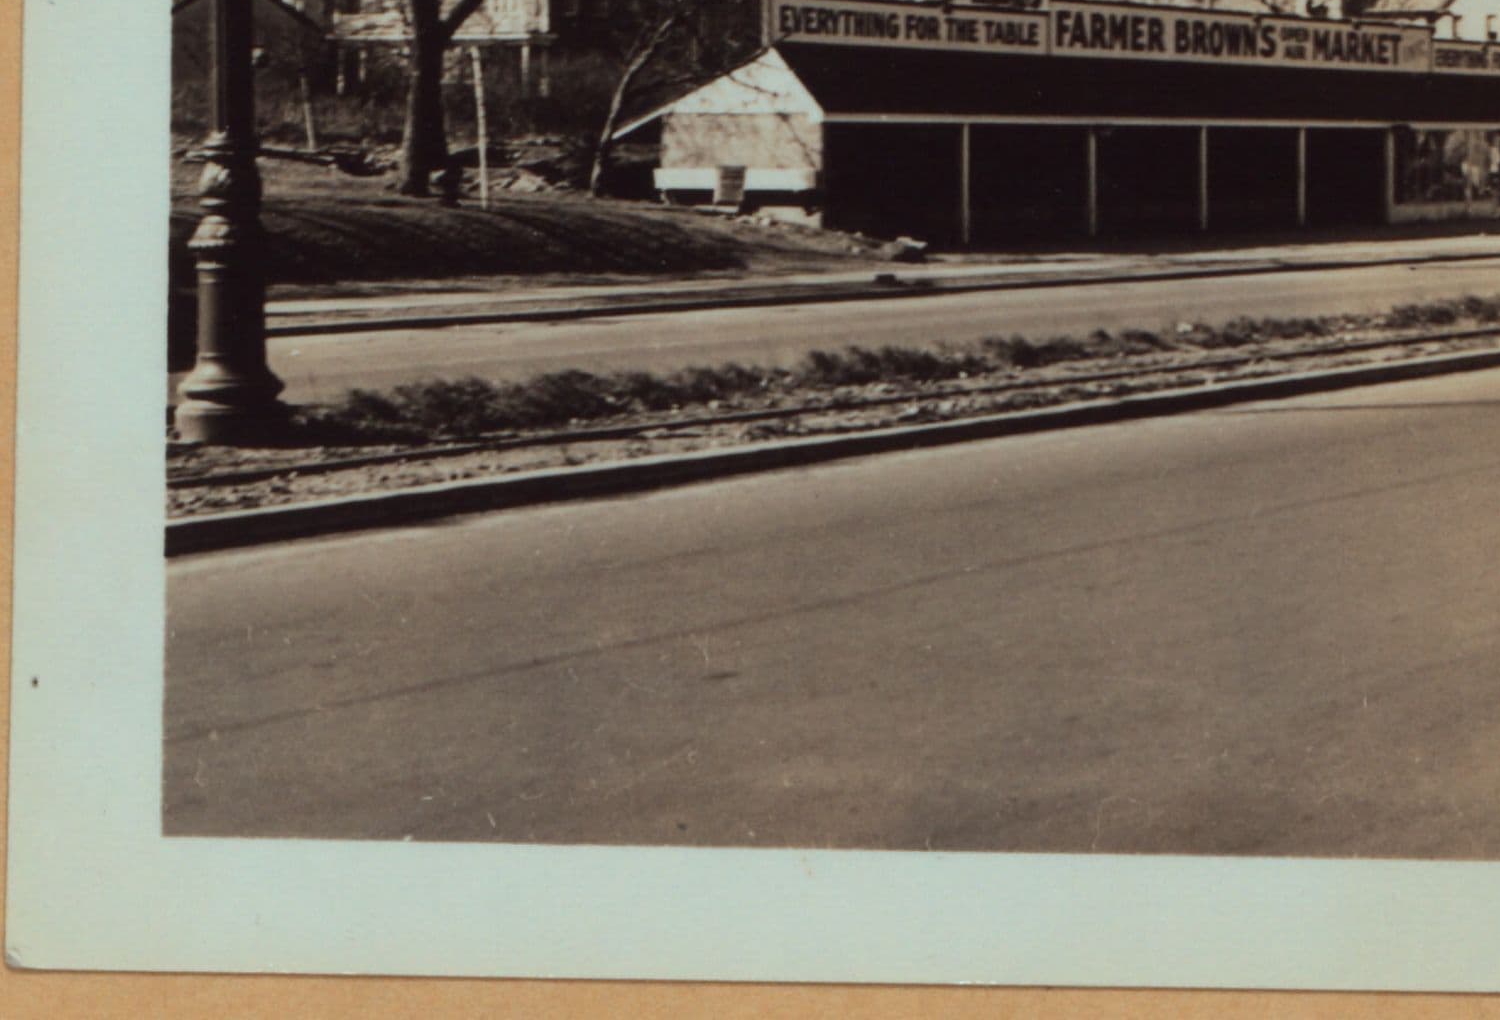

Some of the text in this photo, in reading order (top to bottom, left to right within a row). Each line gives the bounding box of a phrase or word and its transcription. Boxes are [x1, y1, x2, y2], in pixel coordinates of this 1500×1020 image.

[780, 5, 1040, 46] EVERYTHING FOR THE TABLE
[1055, 10, 1168, 53] FARMER
[1312, 29, 1402, 65] MARKET
